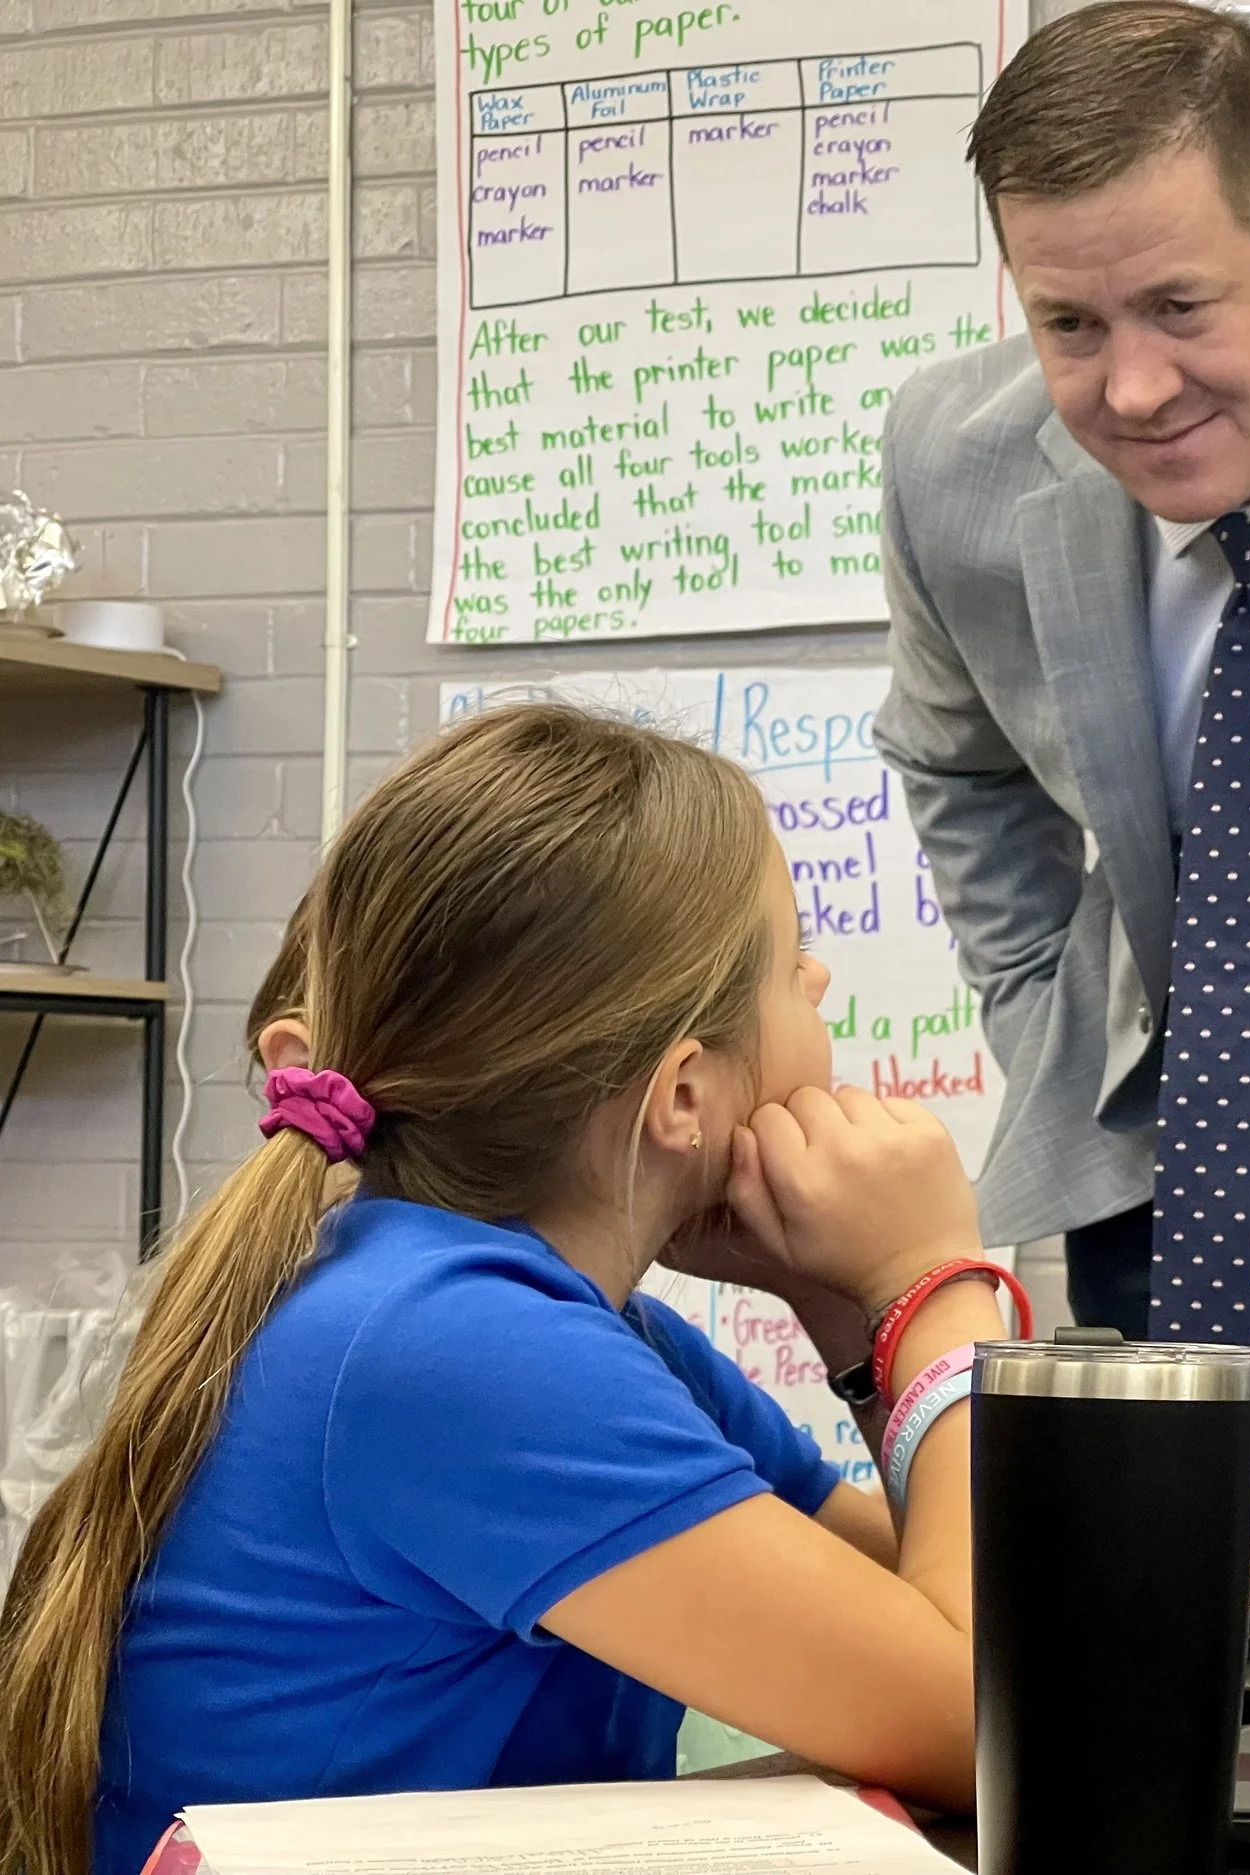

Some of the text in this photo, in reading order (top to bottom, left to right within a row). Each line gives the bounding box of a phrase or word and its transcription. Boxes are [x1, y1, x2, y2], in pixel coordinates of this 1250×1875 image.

[461, 4, 740, 85] types of paper.
[687, 68, 760, 88] Plastic
[819, 58, 896, 80] Printer
[477, 94, 523, 113] Wax
[571, 80, 667, 104] Aluminum
[689, 89, 745, 109] Wrap
[818, 80, 887, 102] Paper
[480, 111, 534, 131] Paper
[591, 101, 625, 119] Foil
[816, 100, 890, 138] pencil
[578, 123, 646, 164] pencil
[688, 114, 780, 144] marker
[476, 134, 542, 177] pencil
[814, 138, 890, 163] crayon
[578, 169, 664, 193] marker
[811, 162, 899, 187] marker
[473, 182, 547, 212] crayon
[808, 193, 868, 215] chalk
[477, 222, 555, 248] marker
[469, 280, 911, 361] After our test, we decided
[468, 313, 992, 411] that the printer paper was the
[466, 383, 835, 461] best material to write
[464, 433, 760, 498] cause all four tools
[461, 470, 766, 540] concluded that the
[459, 508, 811, 581] the best writing tool
[454, 550, 803, 617] was the only tool to
[451, 608, 638, 642] four papers.
[872, 1050, 984, 1100] blocked
[923, 1359, 951, 1384] GIVE
[900, 1381, 957, 1442] NEVER
